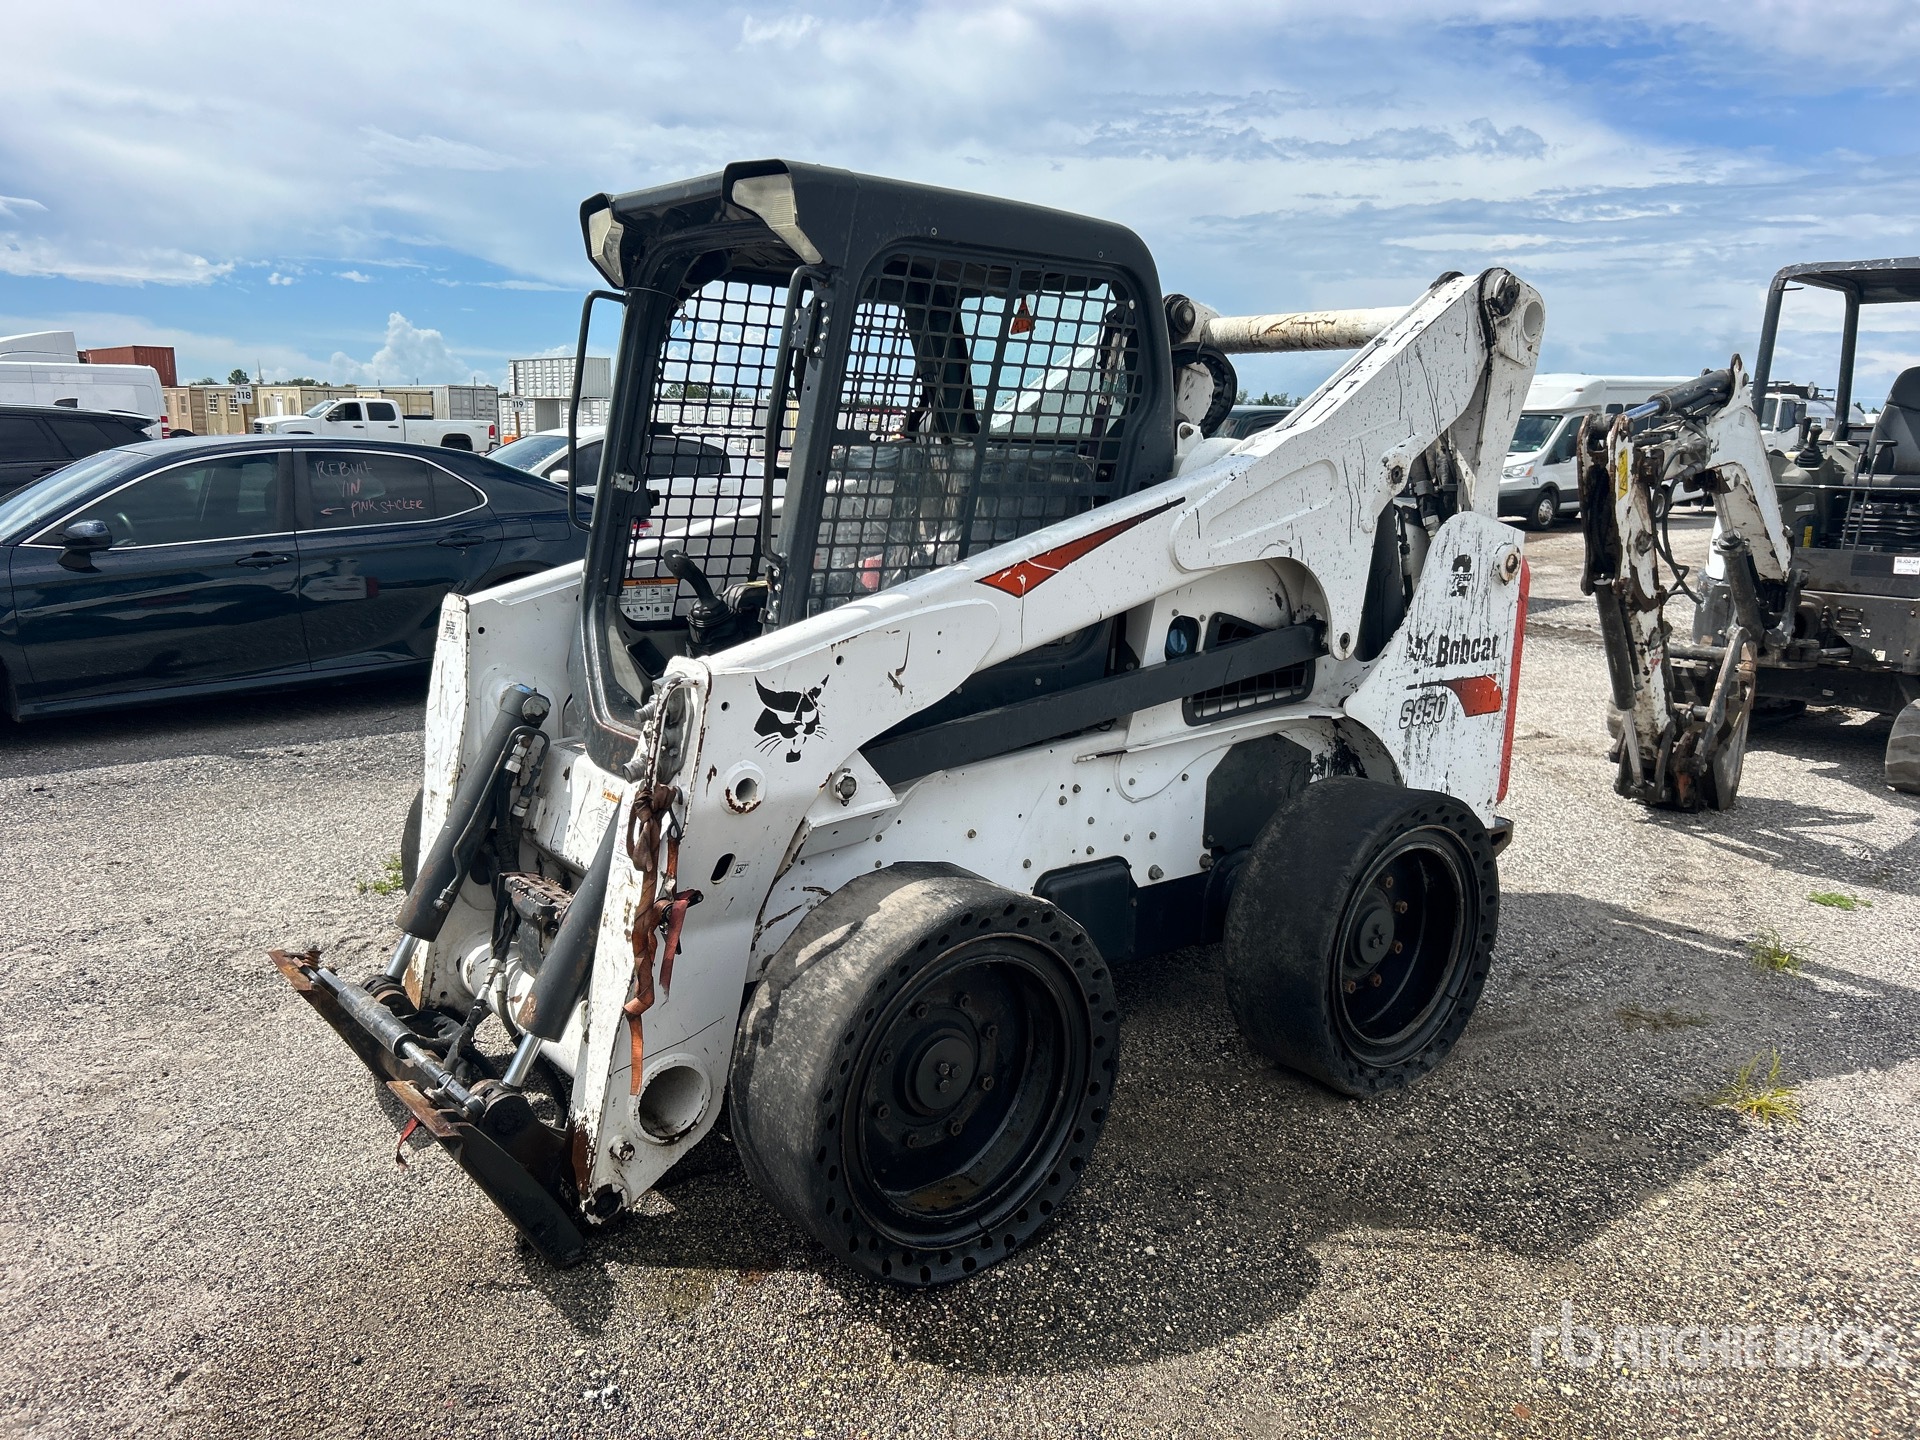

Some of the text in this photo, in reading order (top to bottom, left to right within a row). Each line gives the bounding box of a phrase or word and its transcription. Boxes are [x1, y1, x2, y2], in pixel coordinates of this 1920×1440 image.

[237, 391, 251, 399] 118
[512, 400, 523, 408] 119
[335, 479, 361, 497] VIN
[351, 500, 379, 518] PINK
[1451, 573, 1472, 582] PEED
[1436, 633, 1499, 668] Bobcat
[1399, 693, 1448, 729] S850
